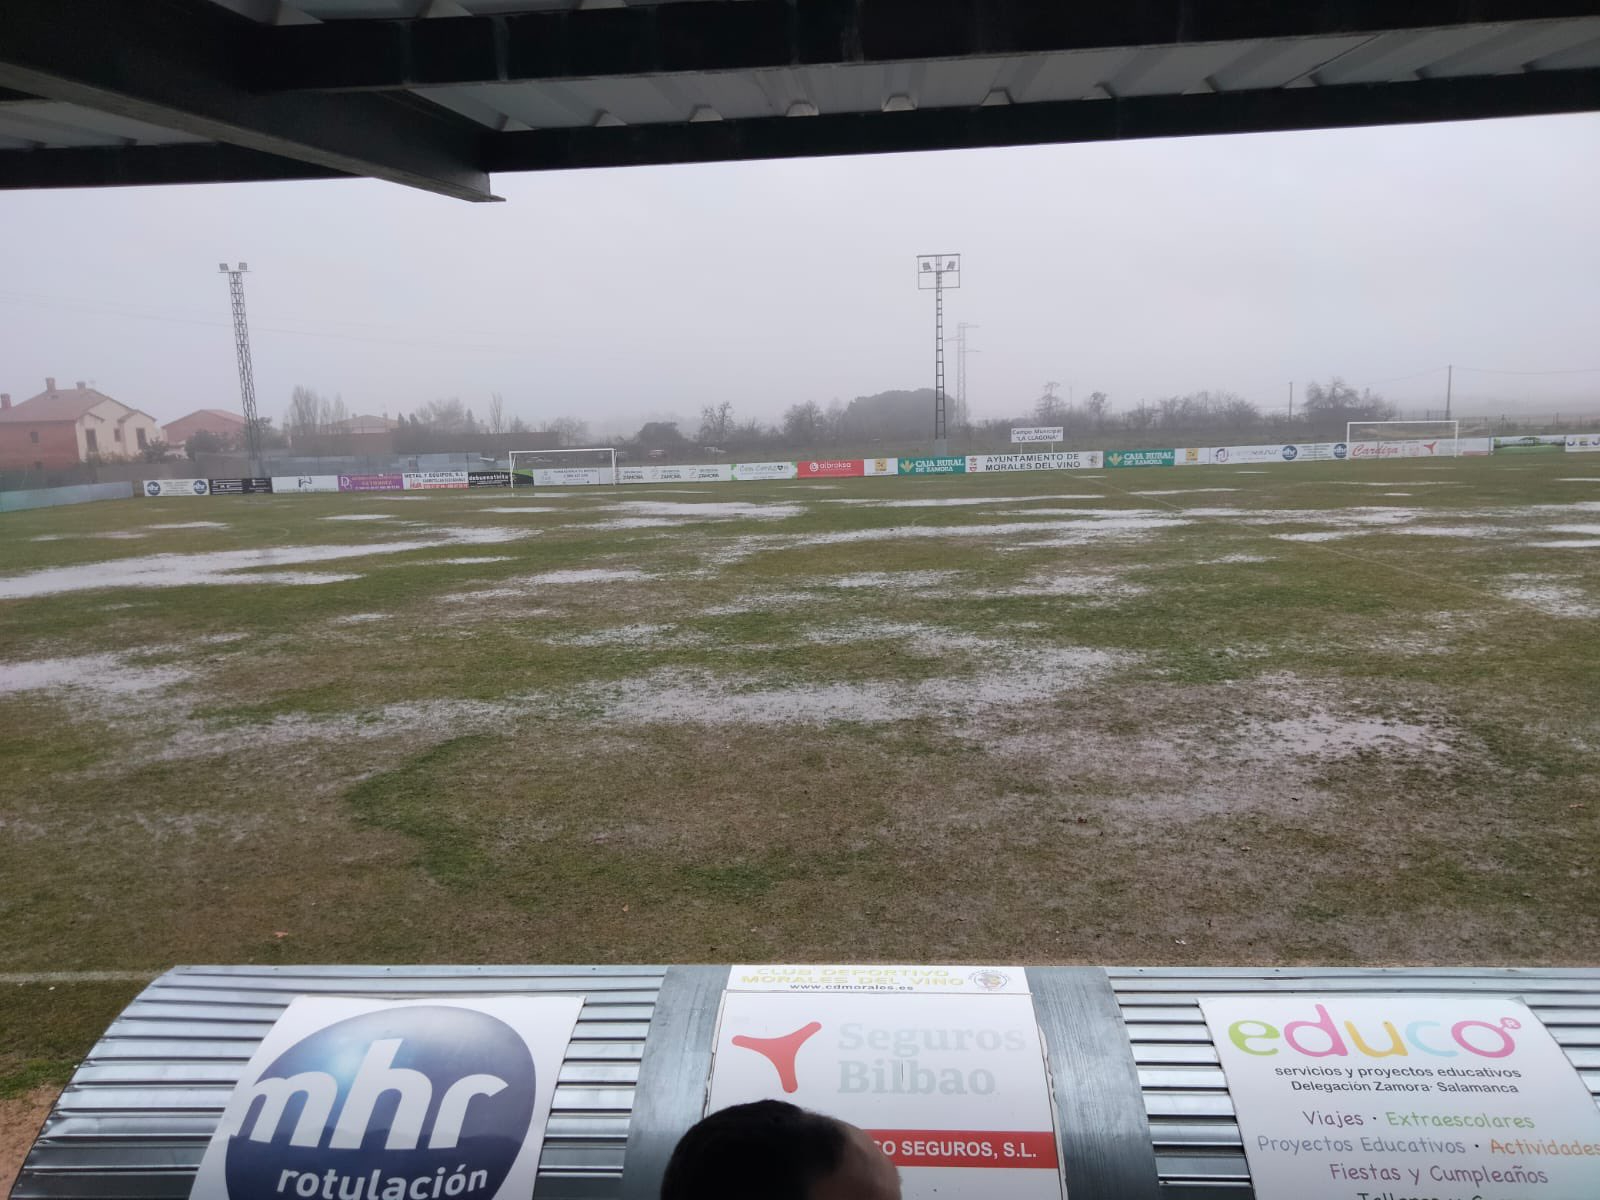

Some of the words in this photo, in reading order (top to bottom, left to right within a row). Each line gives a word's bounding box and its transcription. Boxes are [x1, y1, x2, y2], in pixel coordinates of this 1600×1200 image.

[915, 460, 935, 468] CAJA
[937, 458, 964, 467] RURAL
[986, 453, 1064, 463] AYUNTAMIENTO
[1146, 451, 1174, 460] RURAL
[985, 462, 1033, 471] MORALES
[1035, 461, 1054, 470] DEL
[741, 975, 848, 984] MORALES
[859, 976, 900, 985] DEL
[911, 977, 964, 986] VINO
[823, 968, 949, 977] DEPORTIVO
[837, 1023, 1026, 1058] Seguros
[1228, 1003, 1517, 1059] educo
[837, 1058, 996, 1096] Bilbao
[1275, 1065, 1342, 1077] servicios
[1344, 1068, 1354, 1079] y
[1358, 1066, 1433, 1079] proyectos
[1437, 1066, 1522, 1078] educativos
[230, 1038, 509, 1151] mhr
[1291, 1080, 1371, 1093] Delegación
[1437, 1081, 1519, 1093] Salamanca
[1302, 1110, 1364, 1129] Viajes
[1385, 1111, 1535, 1130] Extraescolares
[901, 1141, 998, 1160] SEGUROS,
[1003, 1142, 1037, 1158] S.L.
[1257, 1135, 1353, 1156] Proyectos
[1360, 1136, 1466, 1154] Educativos
[1490, 1138, 1600, 1157] Actividades
[276, 1163, 488, 1200] rotulación
[1329, 1163, 1401, 1182] Fiestas
[1408, 1166, 1420, 1187] y
[1429, 1164, 1549, 1189] Cumpleaños
